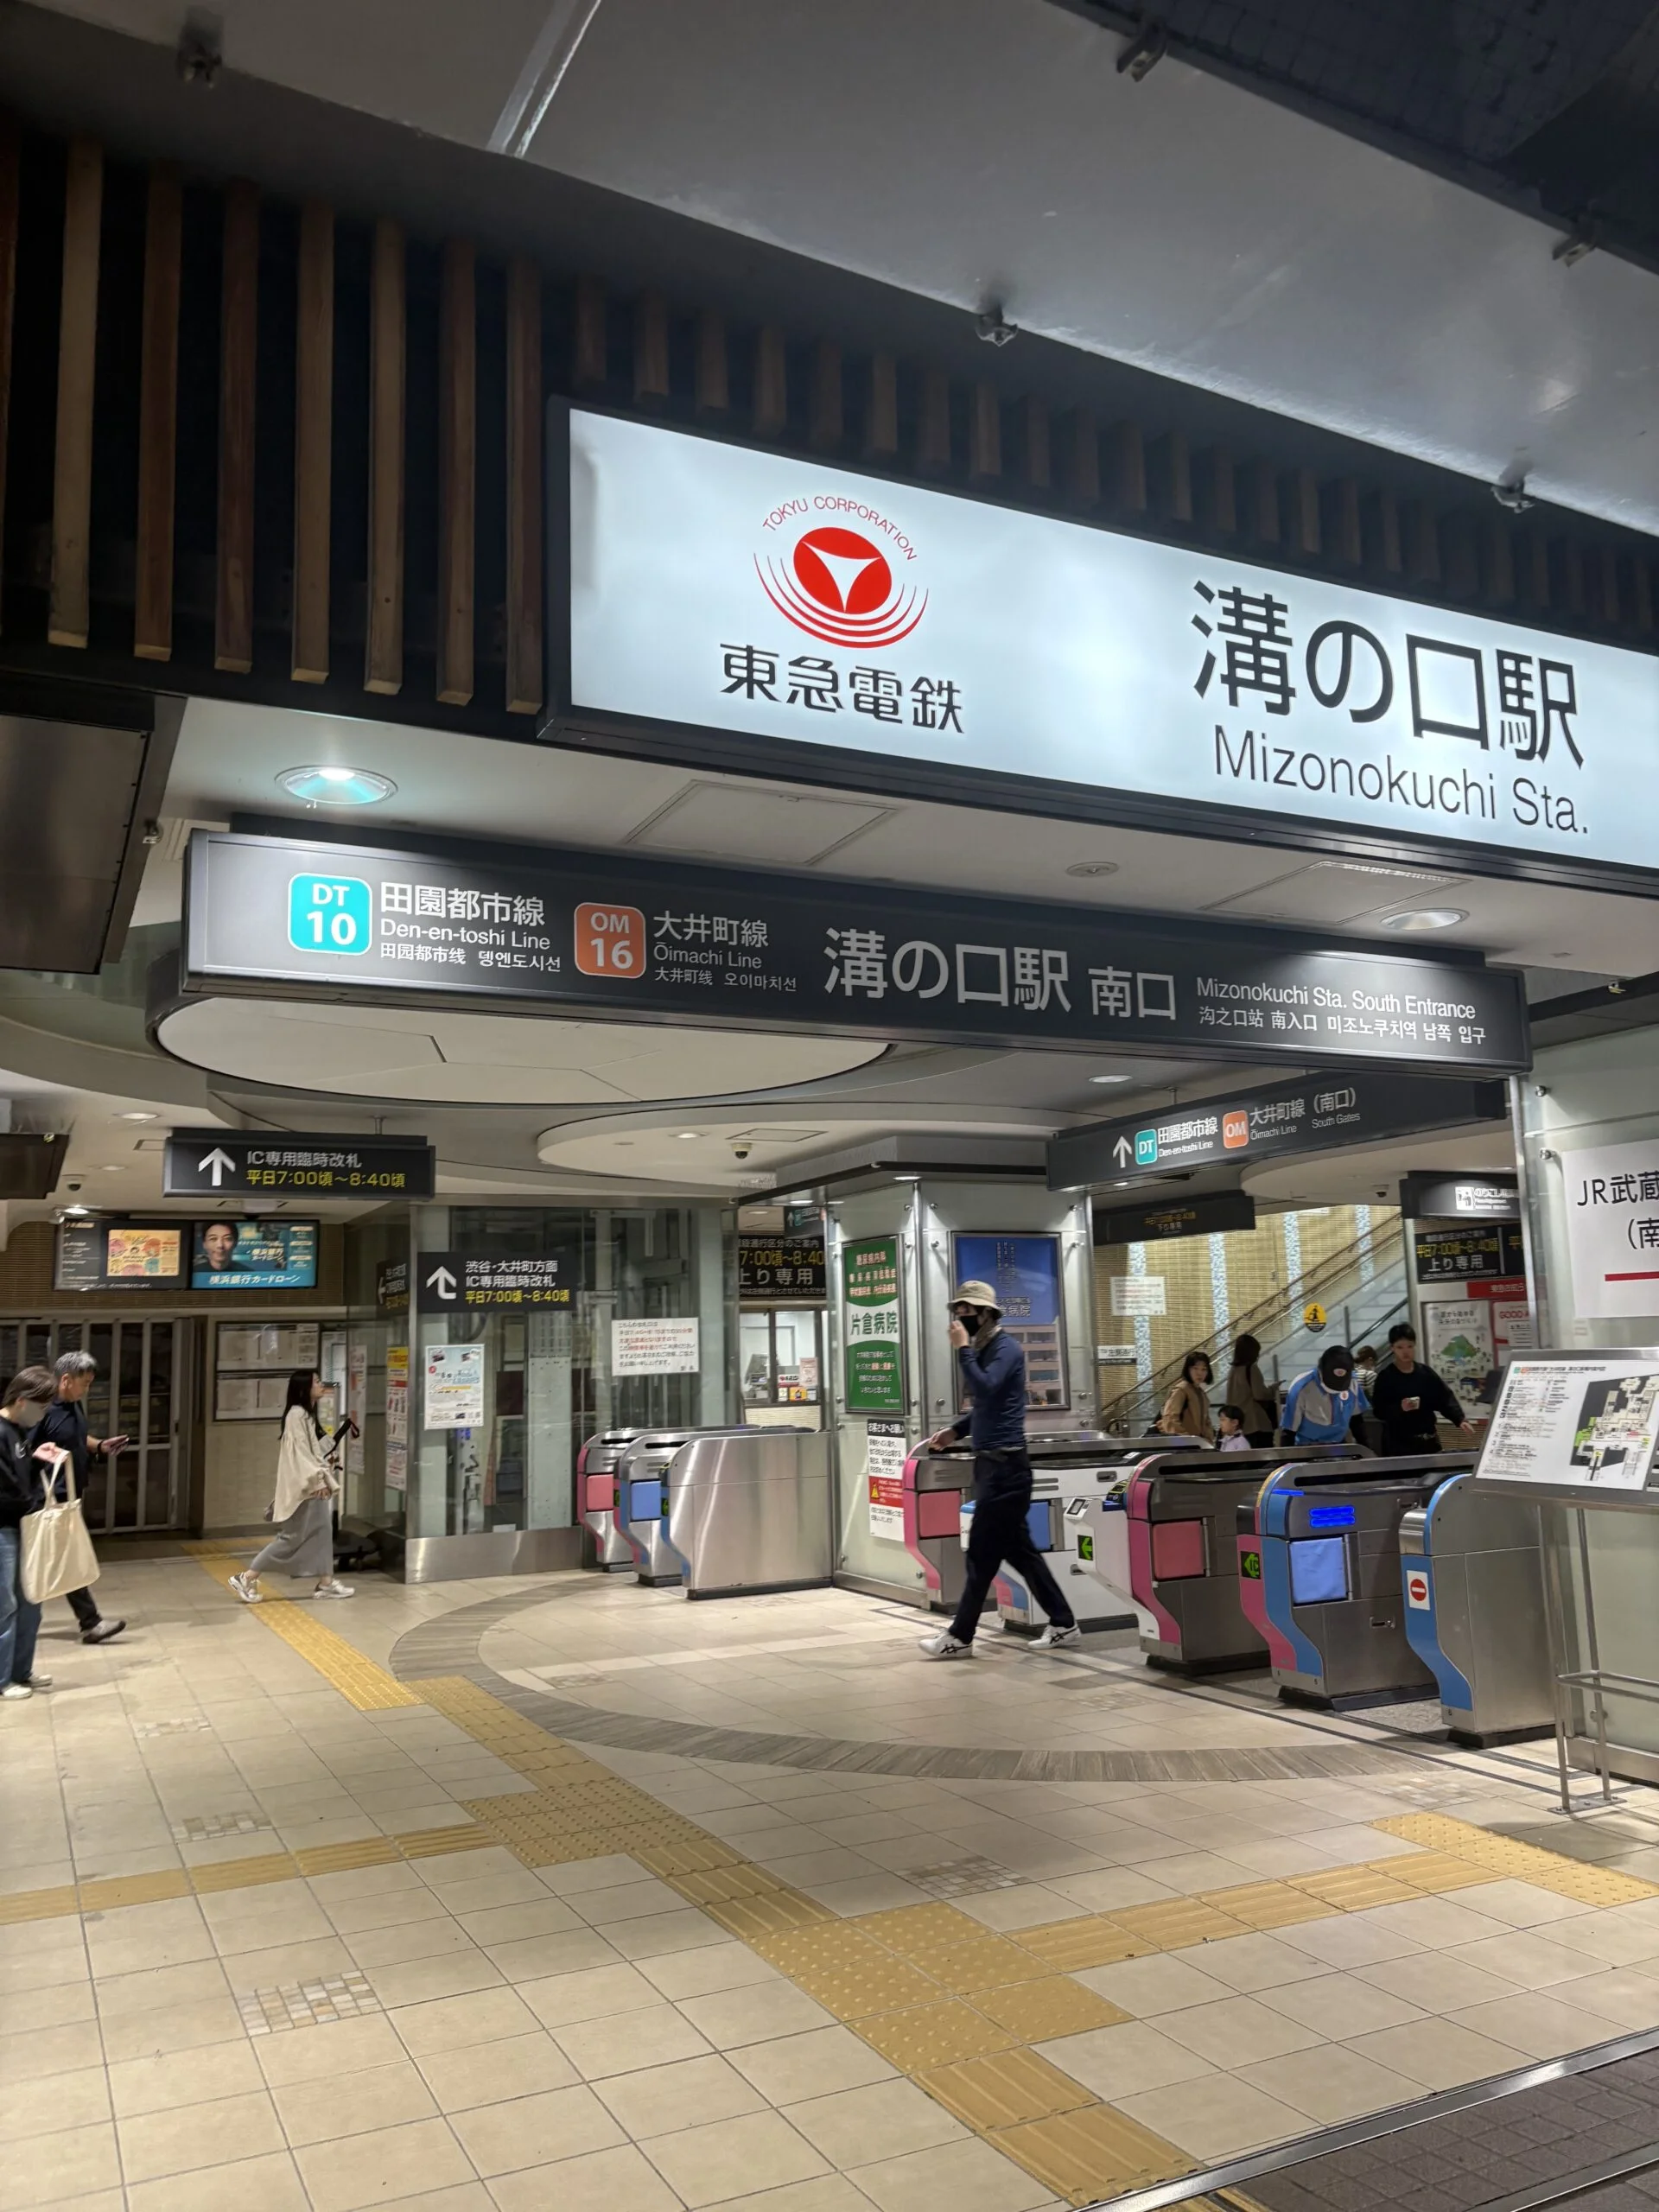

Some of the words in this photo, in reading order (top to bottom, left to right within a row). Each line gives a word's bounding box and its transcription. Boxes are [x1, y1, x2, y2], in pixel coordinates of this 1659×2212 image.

[763, 498, 809, 531] TOKYU
[814, 496, 917, 561] CORPORATION
[1191, 580, 1584, 770] 溝の口駅
[719, 643, 965, 734] 東急電鉄
[1214, 724, 1497, 820] Mizonokuchi
[1512, 776, 1589, 834] Sta.
[312, 883, 350, 906] DT
[380, 881, 545, 927] 田園都市線
[307, 911, 357, 945] 10
[380, 918, 505, 946] Den-en-toshi
[511, 931, 550, 950] Line
[590, 912, 629, 934] OM
[653, 910, 769, 948] 大井町線
[380, 943, 467, 964] 田园都市线
[478, 950, 561, 972] 뎅엔도시선
[590, 938, 633, 969] 16
[728, 950, 762, 969] Line
[654, 967, 714, 986] 大井町线
[724, 972, 797, 992] 오이마치선
[823, 927, 1071, 1013] 溝の口駅
[1088, 965, 1176, 1020] 南口
[1196, 976, 1308, 1005] Mizonokuchi
[1313, 987, 1347, 1008] Sta.
[1352, 990, 1400, 1014] South
[1405, 995, 1476, 1020] Entrance
[1270, 1010, 1318, 1031] 南入口
[1327, 1014, 1417, 1040] 미조노쿠치역
[1423, 1023, 1452, 1043] 남쪽
[1459, 1026, 1486, 1045] 입구
[1249, 1099, 1305, 1127] 大井町線
[1312, 1116, 1335, 1129] South
[1157, 1116, 1218, 1145] 田園都市線
[1225, 1122, 1246, 1138] OM
[1281, 1124, 1297, 1136] Line
[1138, 1139, 1154, 1155] DT
[1198, 1140, 1214, 1151] Line
[247, 1150, 362, 1168] IC専用臨時改札
[1577, 1170, 1659, 1206] JR武蔵
[1427, 1254, 1484, 1272] 上り専用
[465, 1274, 556, 1287] IC専用臨時改札
[740, 1268, 813, 1285] 上り専用
[850, 1311, 898, 1335] 片倉病院
